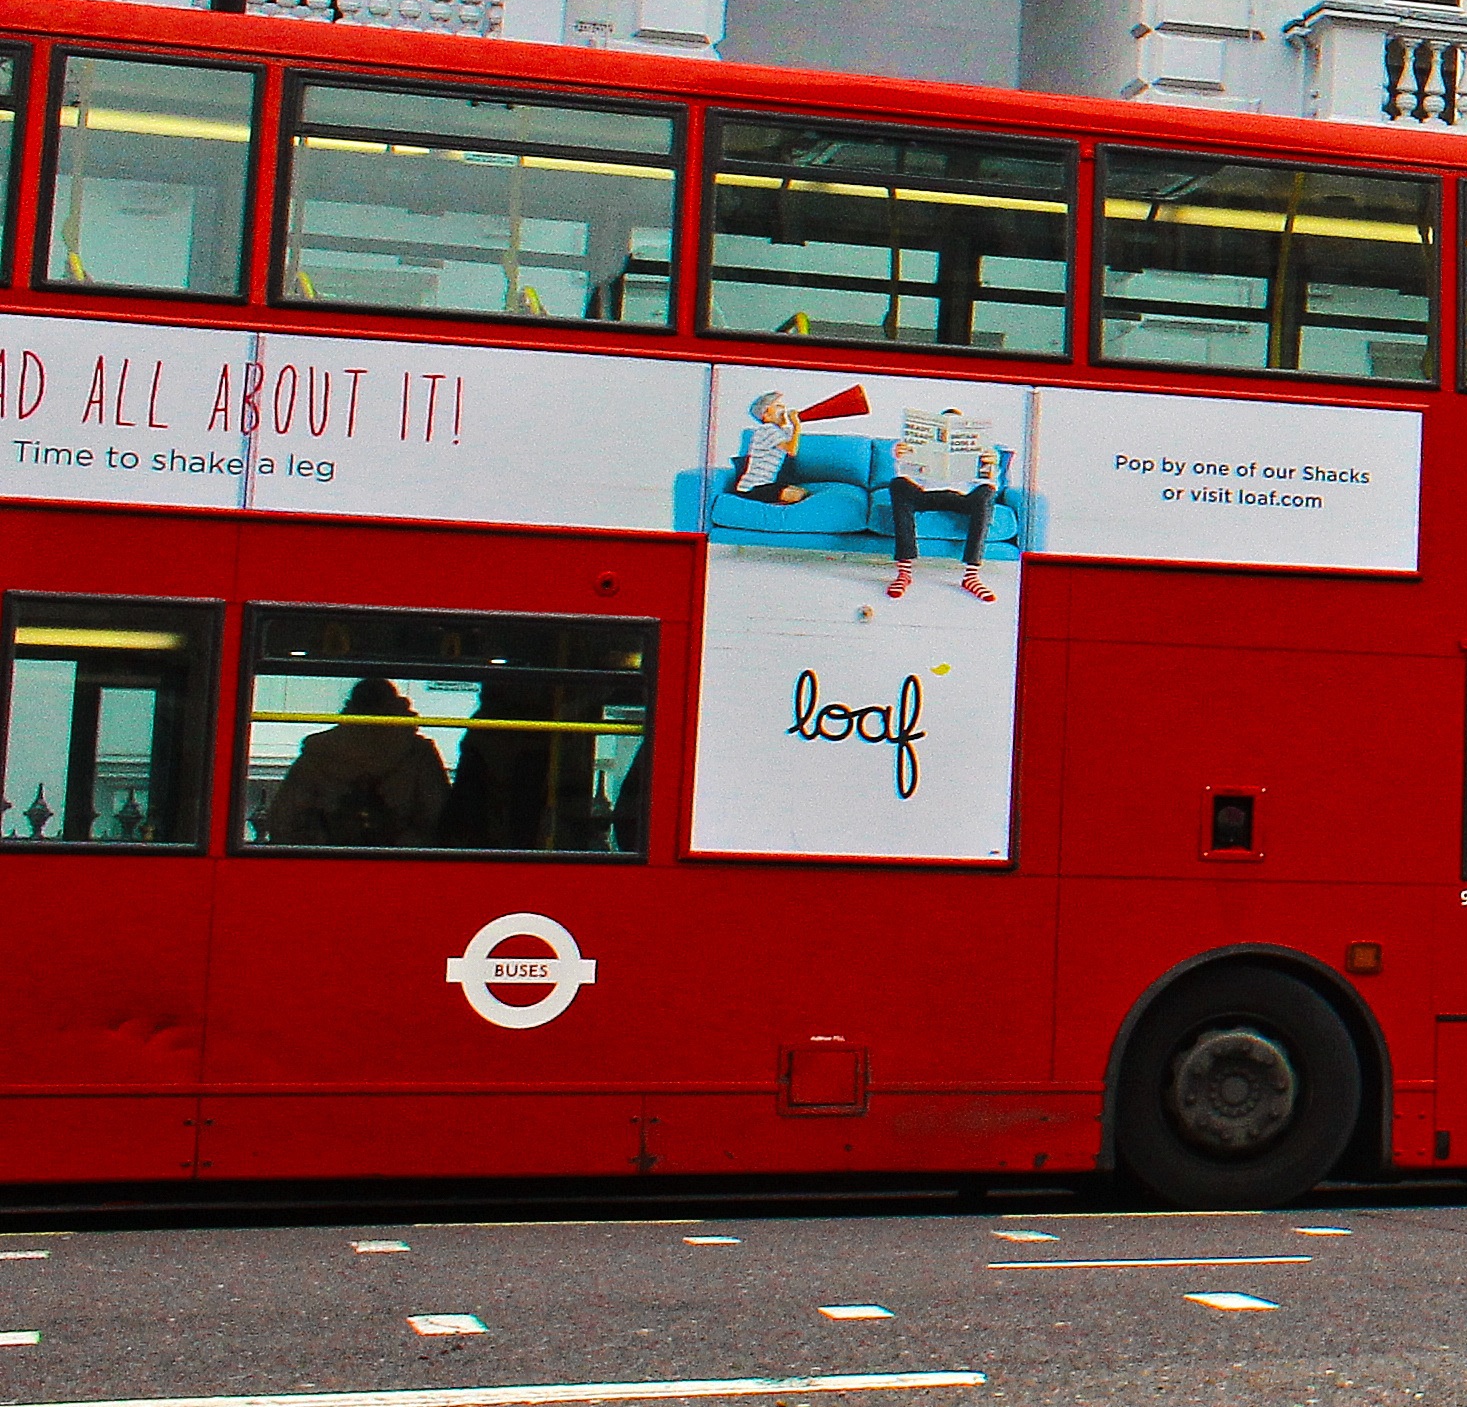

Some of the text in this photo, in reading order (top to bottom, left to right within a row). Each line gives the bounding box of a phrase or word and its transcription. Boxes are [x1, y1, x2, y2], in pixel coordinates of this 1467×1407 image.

[81, 355, 168, 429] ALL
[207, 362, 368, 438] ABOUT
[400, 371, 465, 445] IT!
[13, 440, 336, 482] Time to shake a leg
[1114, 454, 1371, 484] Pop by one of our Shacks
[1162, 486, 1323, 509] or visit loaf.com
[787, 669, 927, 800] loaf
[494, 963, 549, 979] BUSES
